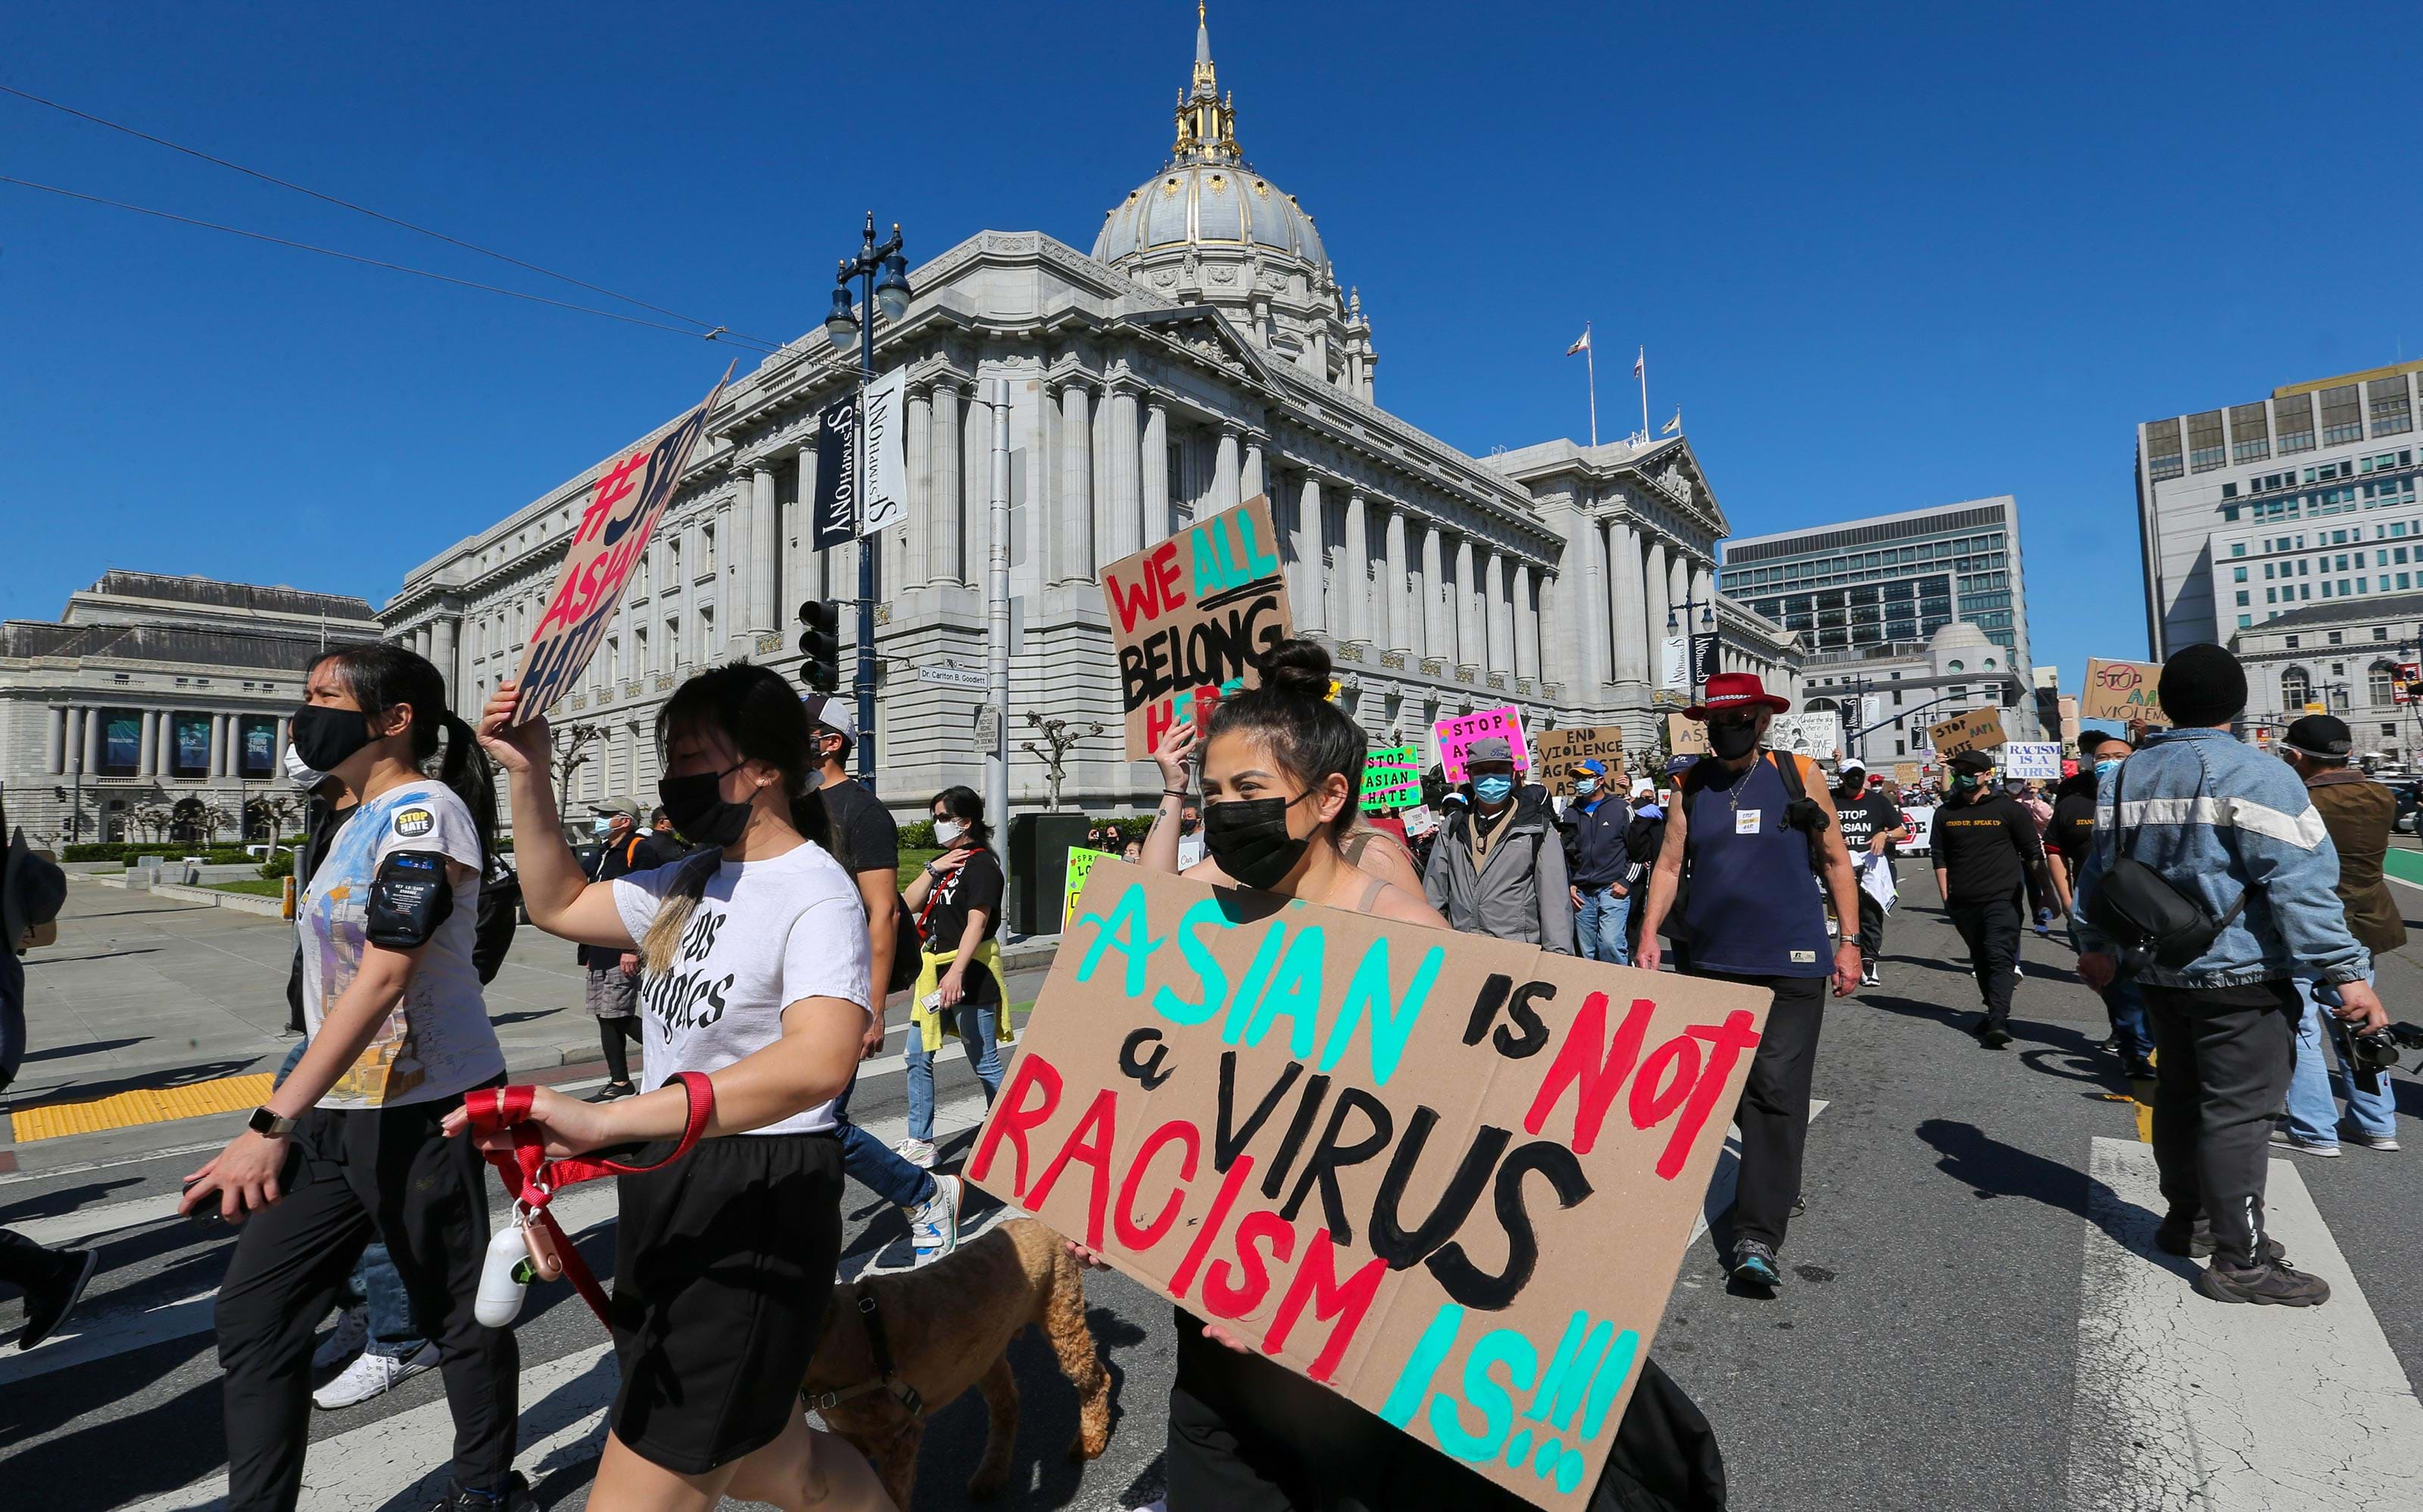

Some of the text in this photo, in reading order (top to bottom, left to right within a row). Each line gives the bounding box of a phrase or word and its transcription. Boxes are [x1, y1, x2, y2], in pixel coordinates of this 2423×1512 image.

[572, 406, 709, 547] #STO
[1106, 508, 1277, 634] WE ALL
[1118, 595, 1283, 715] BELONG
[921, 669, 931, 678] Dr.
[932, 671, 953, 681] Carlton
[962, 675, 985, 684] Goodlett
[2096, 671, 2142, 688] STOP
[2126, 688, 2159, 707] AA
[1146, 676, 1244, 754] HER
[2100, 705, 2170, 722] VIOLENC
[1453, 715, 1502, 737] STOP
[1935, 720, 1966, 738] STOP
[1969, 722, 1994, 738] AAPI
[1567, 728, 1596, 744] END
[1539, 740, 1623, 762] VIOLENCE
[1801, 747, 1832, 759] FAMIL
[2010, 745, 2060, 755] RACISM
[1368, 753, 1405, 769] STOP
[1542, 759, 1621, 778] AGAST
[2019, 756, 2048, 765] IS A
[1366, 772, 1409, 788] ASIAN
[2012, 768, 2056, 778] VIRUS
[1368, 789, 1408, 805] HATE
[399, 811, 429, 825] STOP
[1837, 809, 1868, 820] STOP
[401, 820, 429, 834] HATE
[1840, 823, 1871, 832] SIAN
[1845, 835, 1866, 846] ATE
[1077, 854, 1096, 862] SPR
[1181, 854, 1193, 865] Our
[1076, 883, 1445, 1086] ASIAN
[1462, 974, 1558, 1058] IS
[1213, 1051, 1593, 1311] VIRUS
[969, 1052, 1389, 1384] RACISM
